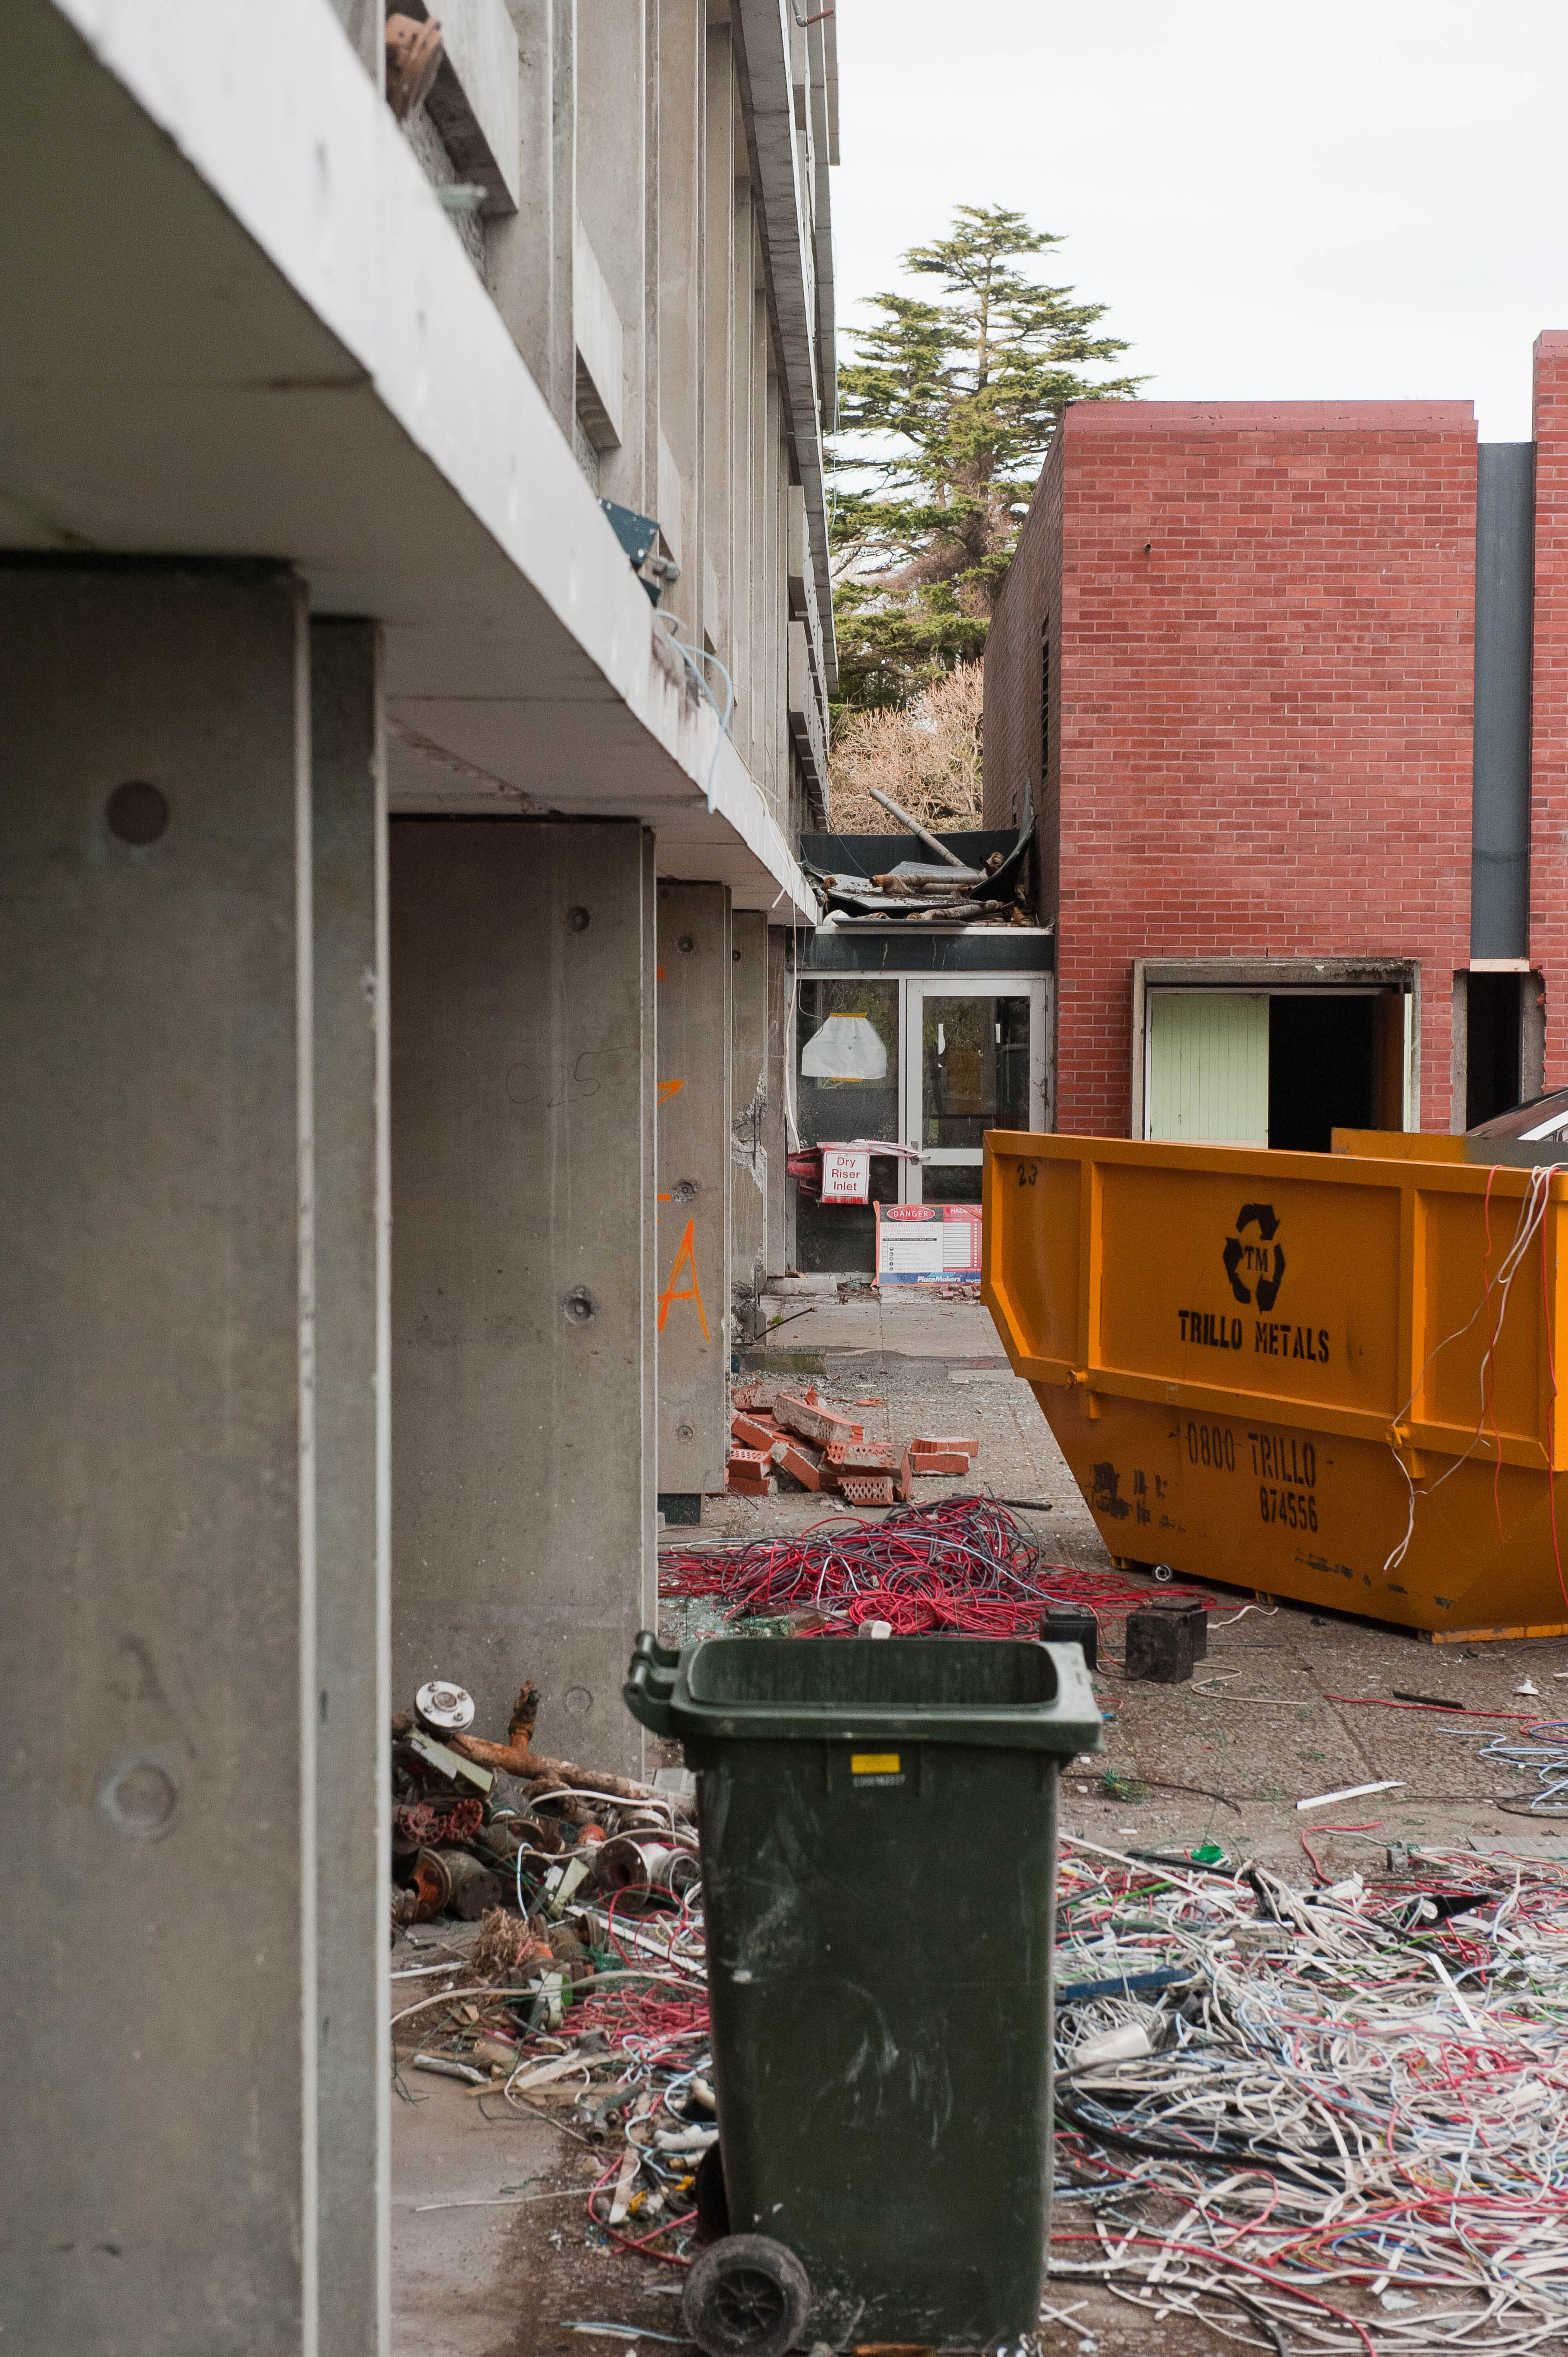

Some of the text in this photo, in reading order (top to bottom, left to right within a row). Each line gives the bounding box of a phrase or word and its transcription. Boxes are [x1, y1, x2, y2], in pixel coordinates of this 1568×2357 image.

[831, 1169, 860, 1179] Riser
[837, 1157, 856, 1168] Dry
[1017, 1163, 1037, 1187] 23
[833, 1181, 857, 1190] Inlet
[1244, 1246, 1269, 1272] TM
[1178, 1310, 1329, 1363] TRILLO METALS
[1188, 1422, 1316, 1488] 0800 TRILLO
[1260, 1485, 1318, 1533] 874556
